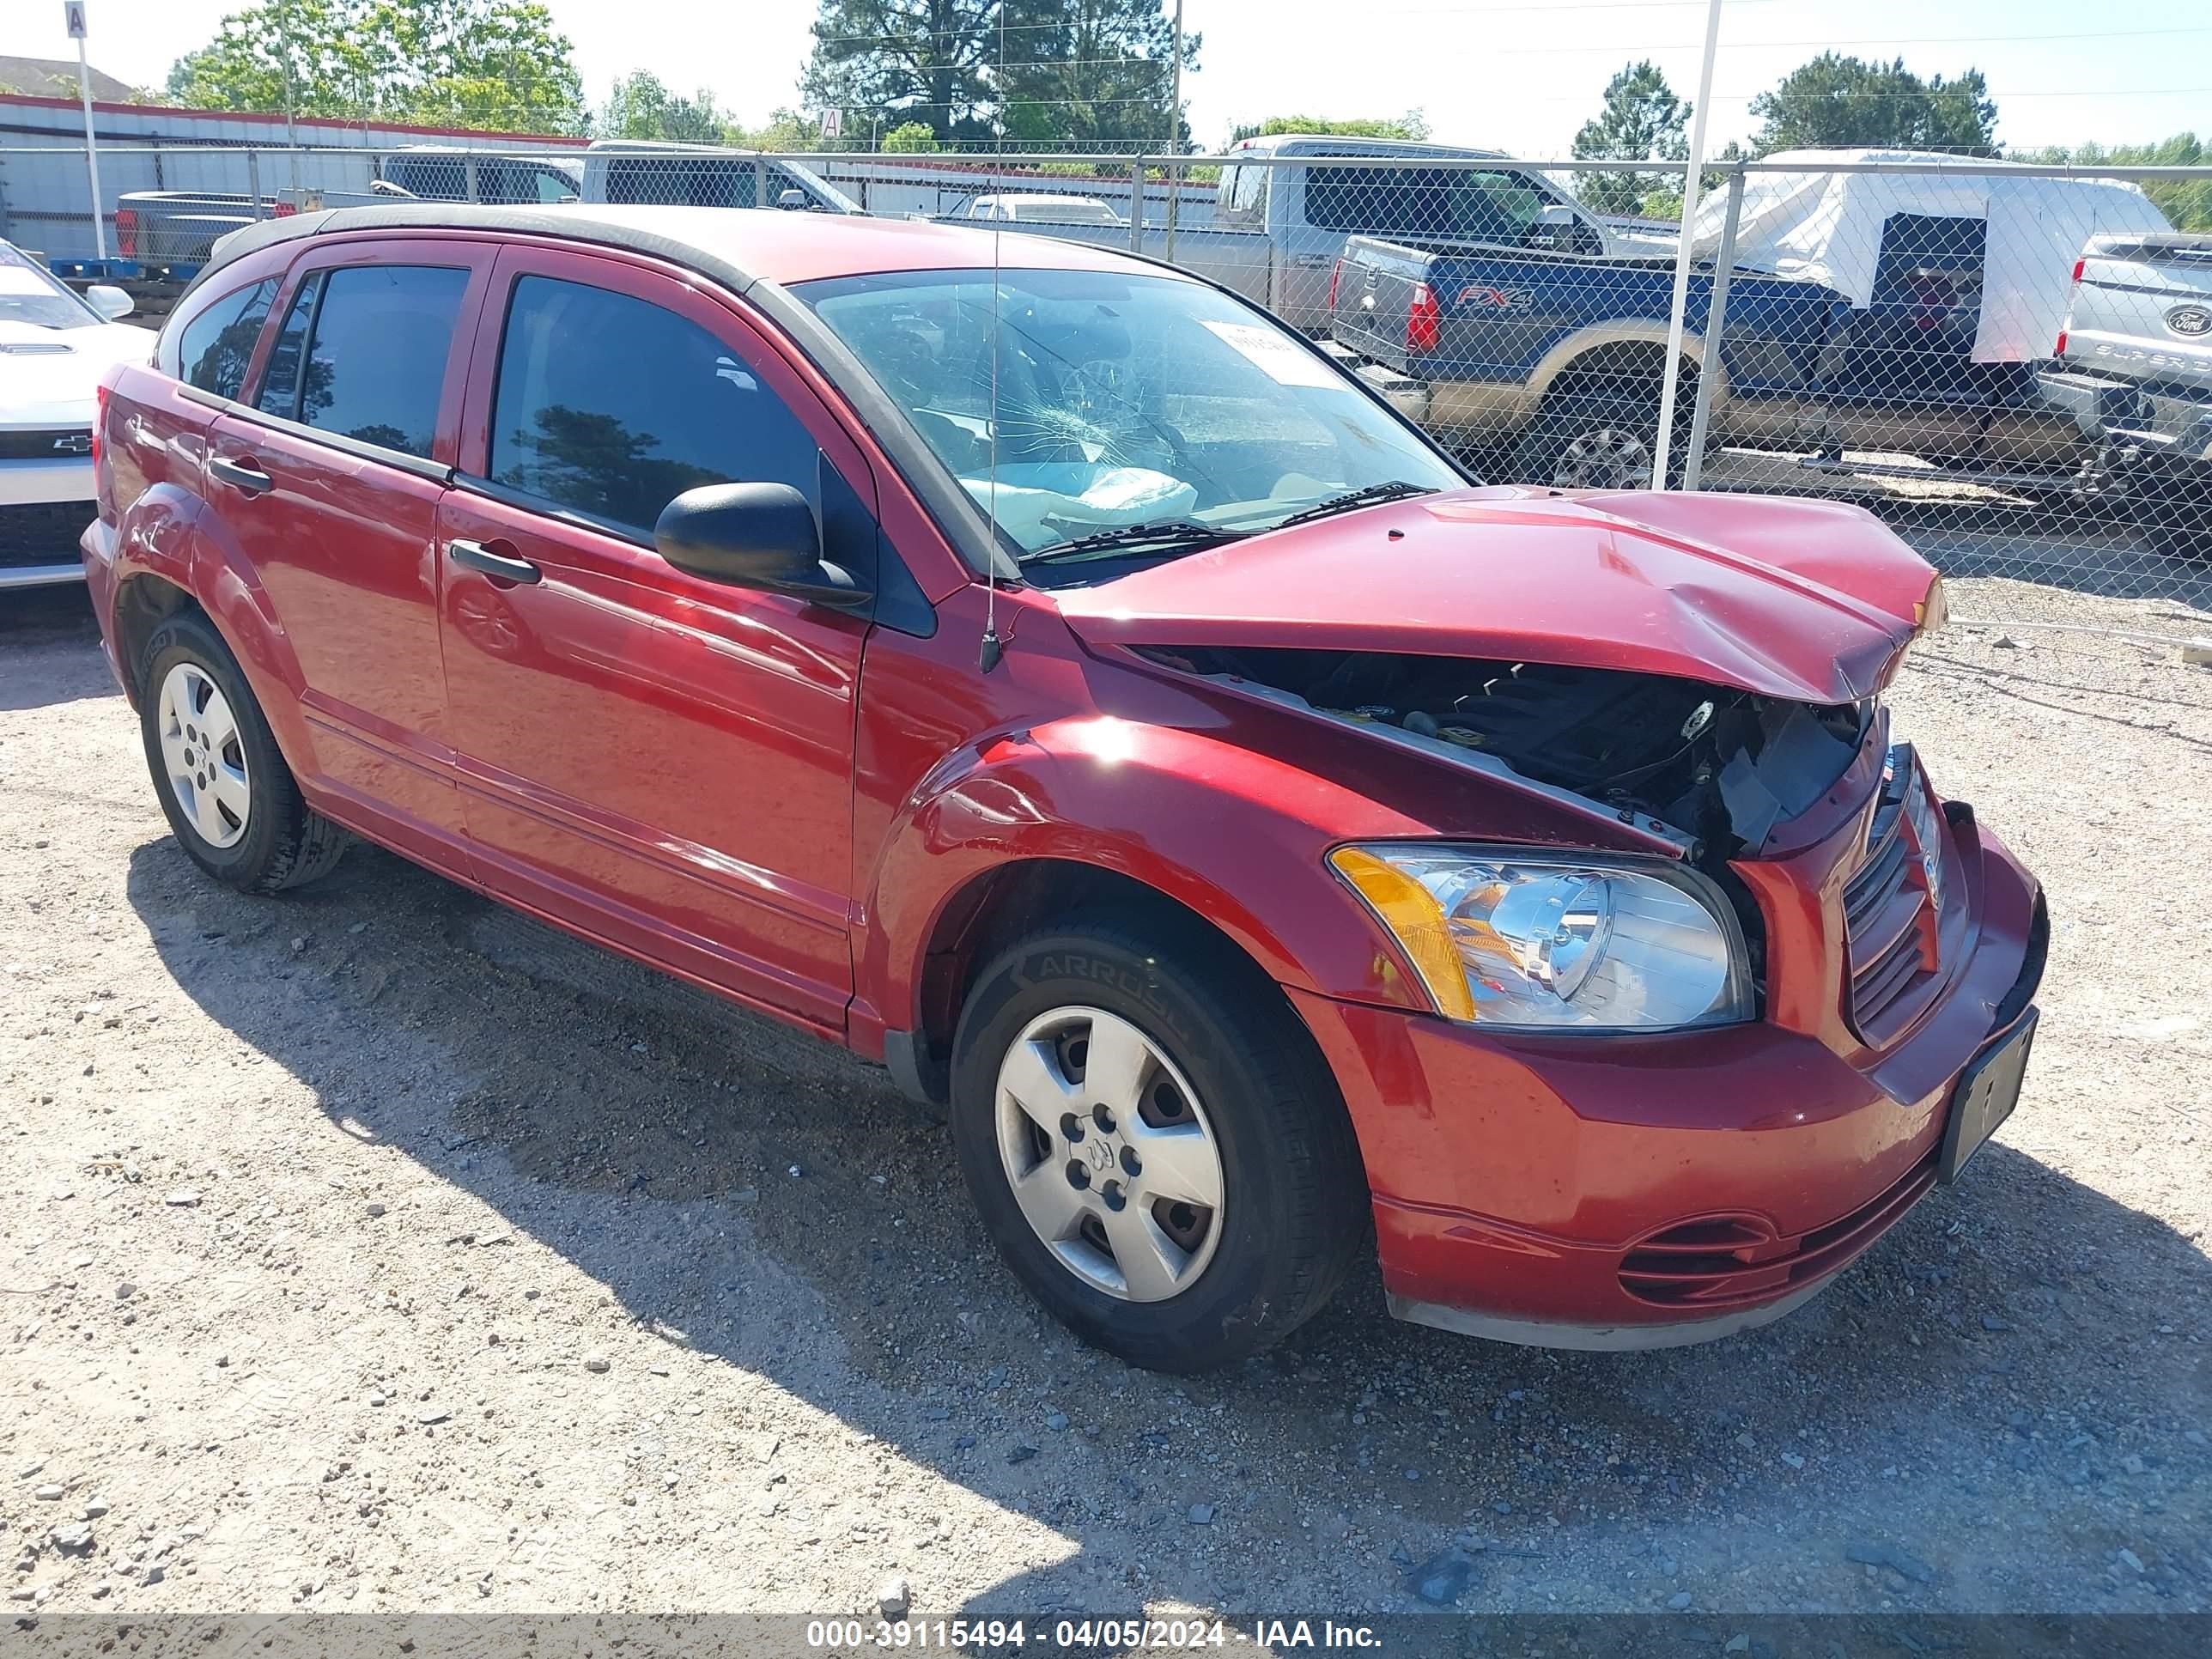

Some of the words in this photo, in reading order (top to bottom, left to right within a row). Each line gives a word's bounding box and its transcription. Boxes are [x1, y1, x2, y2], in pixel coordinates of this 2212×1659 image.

[70, 7, 83, 32] A
[823, 111, 837, 137] A
[1455, 287, 1534, 307] FX4
[2175, 313, 2205, 332] Ford
[2094, 344, 2185, 368] SUPER
